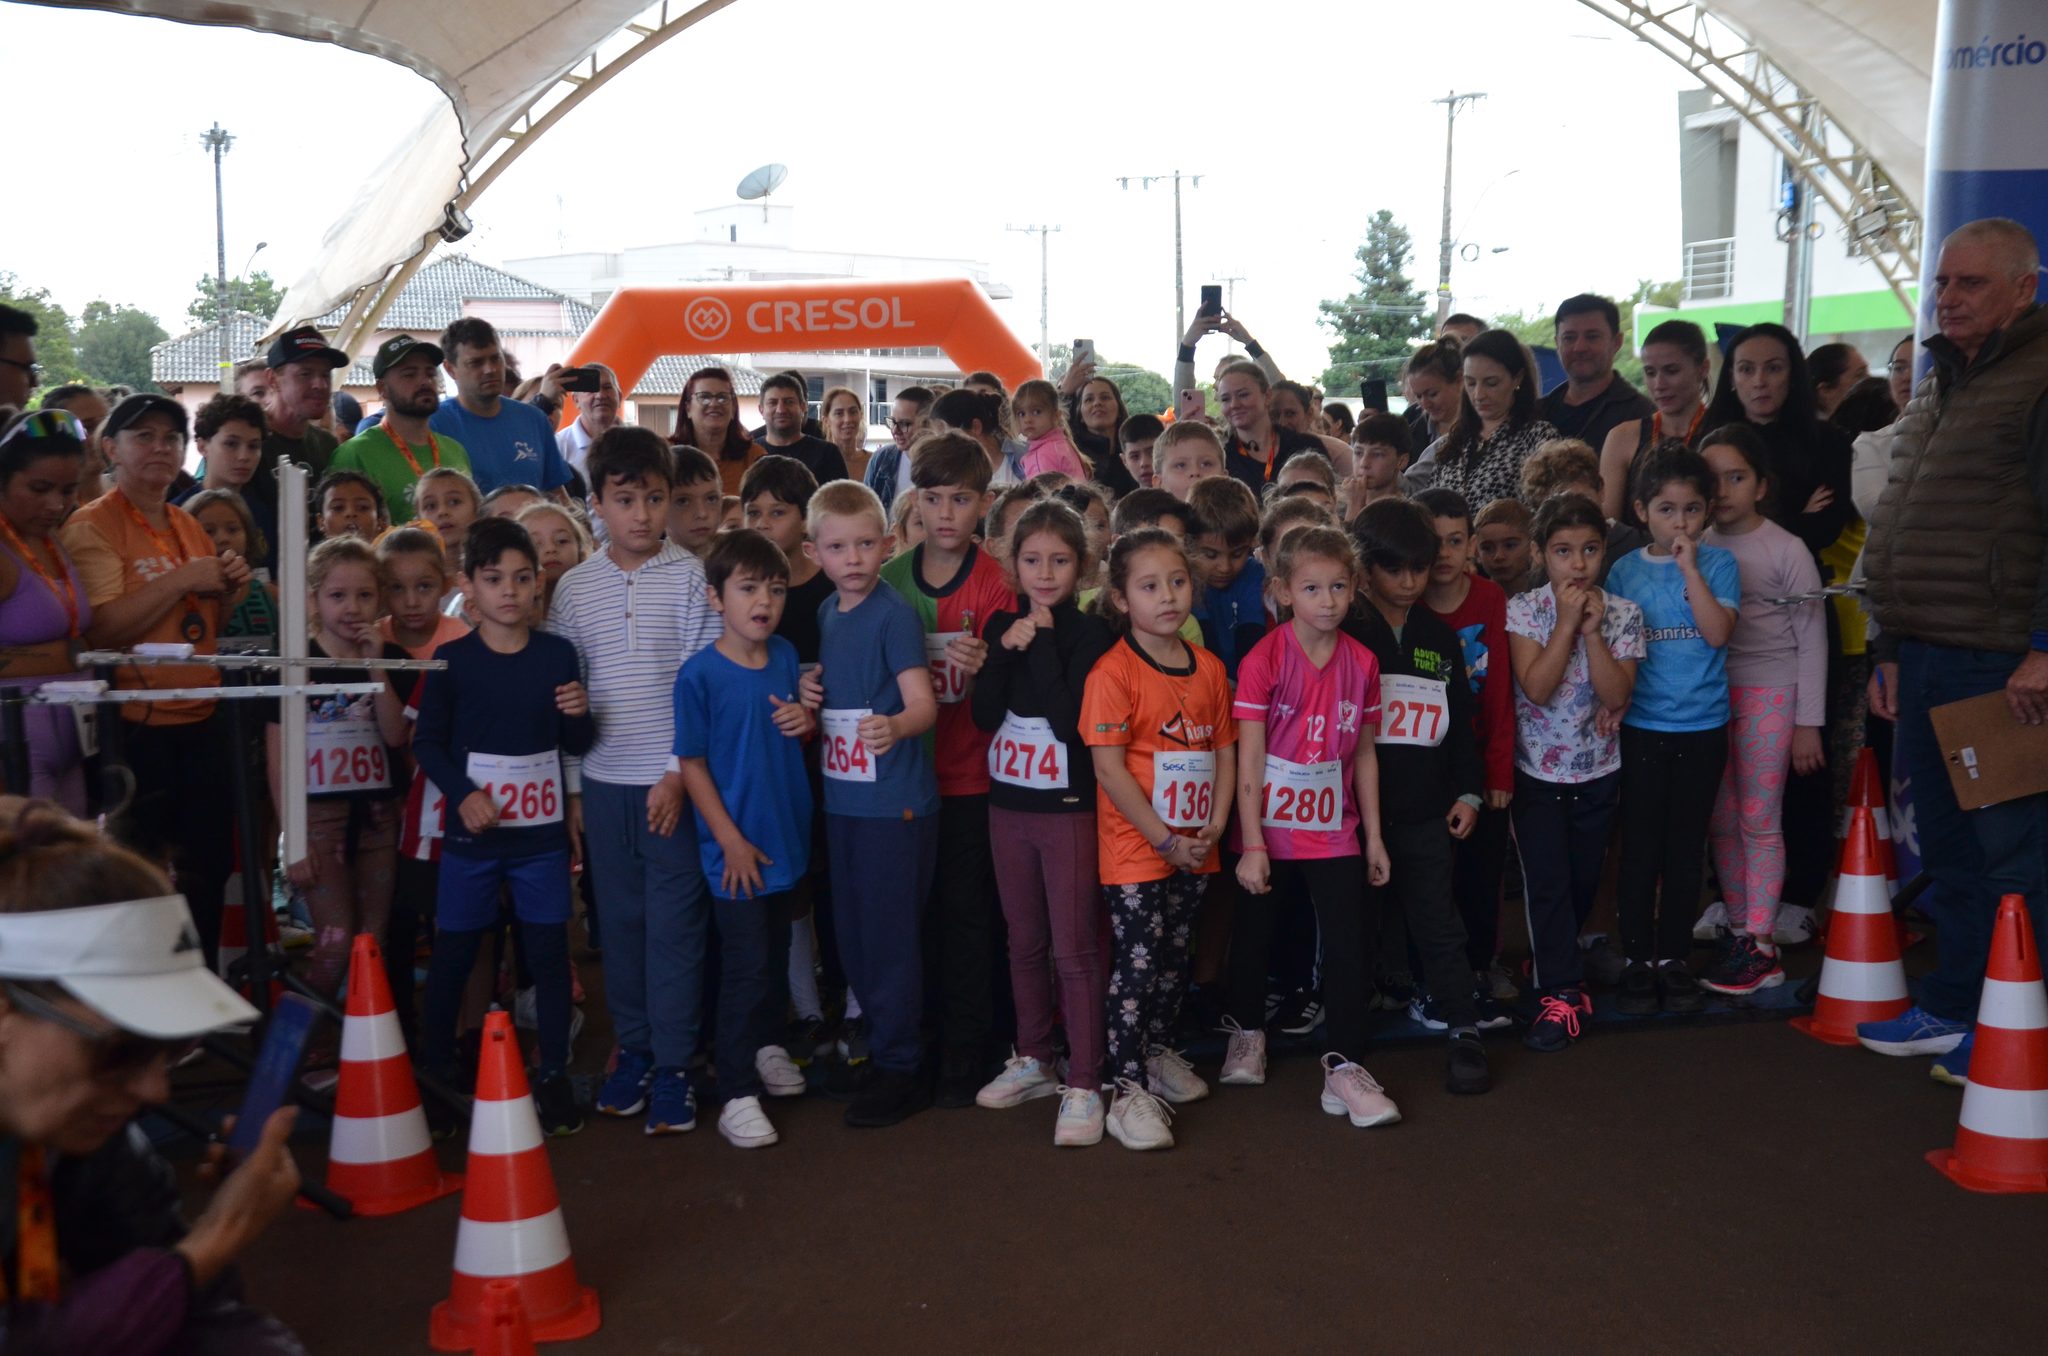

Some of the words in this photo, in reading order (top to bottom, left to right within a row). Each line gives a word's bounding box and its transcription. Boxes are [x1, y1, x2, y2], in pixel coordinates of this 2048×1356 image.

[746, 296, 916, 333] CRESOL
[1306, 714, 1326, 743] 12
[309, 745, 385, 786] 1269
[994, 735, 1060, 781] 1274
[1163, 780, 1212, 821] 136
[1261, 781, 1335, 824] 1280
